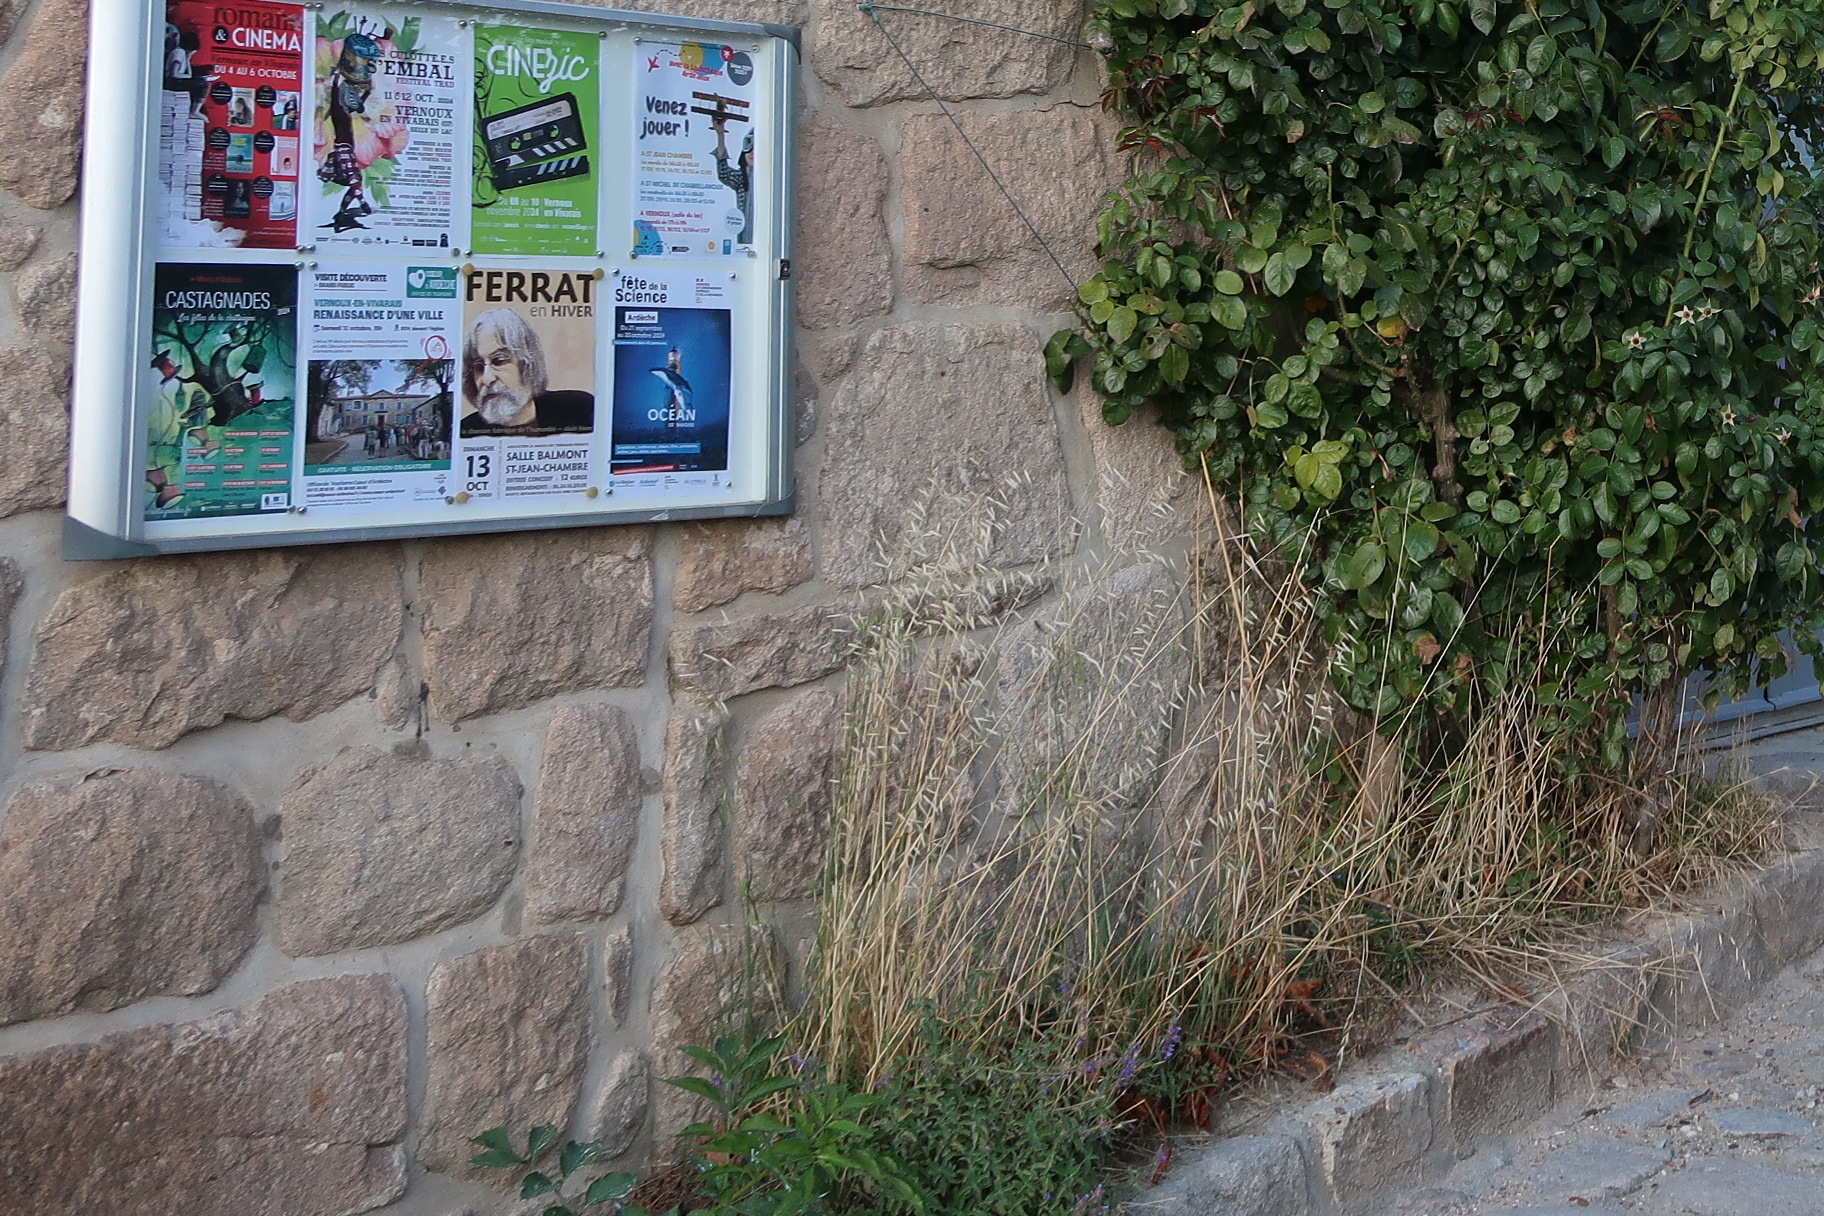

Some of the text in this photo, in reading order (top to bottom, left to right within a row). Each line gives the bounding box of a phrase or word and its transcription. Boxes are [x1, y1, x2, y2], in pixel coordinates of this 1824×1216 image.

[232, 27, 302, 52] CINEMA
[214, 65, 297, 80] DU 4 AU 6 OCTOBRE
[384, 91, 392, 100] 11
[402, 92, 411, 101] 12
[395, 105, 453, 119] VERNOUX
[646, 95, 688, 116] Venez
[380, 115, 391, 123] EN
[396, 116, 439, 126] VIVARAIS
[639, 117, 690, 140] jouer !
[543, 197, 573, 208] Vernoux
[544, 208, 582, 218] en Vivarais
[645, 210, 671, 218] VERNOUX
[314, 272, 387, 283] VISITE DÉCOUVERTE
[621, 275, 668, 291] fête de la
[466, 270, 595, 303] FERRAT
[166, 290, 271, 310] CASTAGNADES
[615, 288, 668, 304] Science
[313, 309, 444, 320] RENAISSANCE D'UNE VILLE
[530, 305, 593, 317] en HIVER
[627, 313, 656, 321] Ardèche
[647, 404, 696, 422] OCÉAN
[506, 449, 588, 462] SALLE BALMONT
[466, 454, 491, 478] 13
[561, 473, 568, 481] 12
[466, 481, 489, 491] OCT
